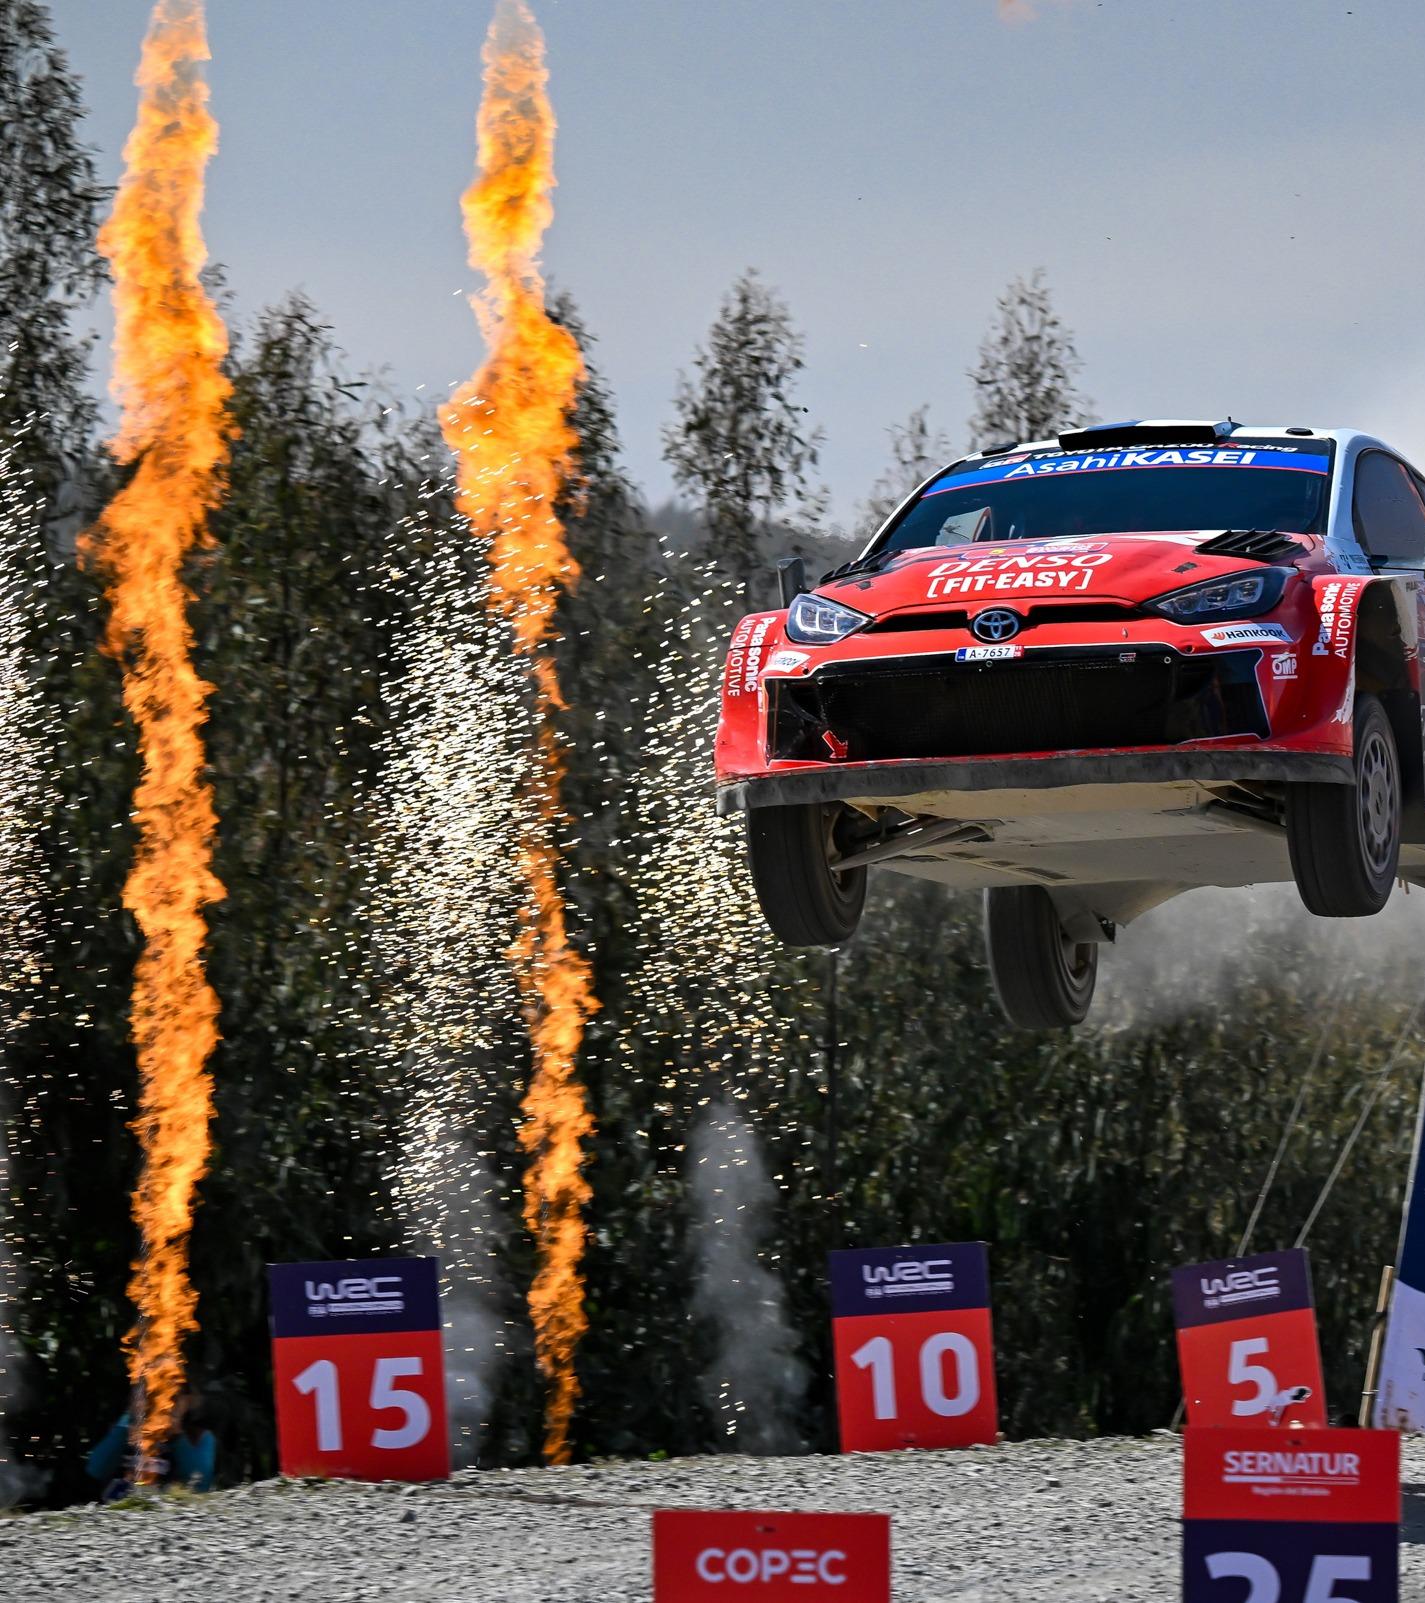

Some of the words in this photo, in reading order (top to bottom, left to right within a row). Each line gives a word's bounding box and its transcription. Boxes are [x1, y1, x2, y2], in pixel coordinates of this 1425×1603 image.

[1004, 451, 1256, 478] AsahiKASEI
[927, 553, 1114, 578] DENSO
[1312, 582, 1343, 656] Panasonic
[1334, 582, 1361, 659] AUTOMOTIVE
[727, 619, 756, 697] AUTOMOTIVE
[744, 617, 777, 692] Panasonic
[969, 647, 1011, 659] A-7657
[305, 1276, 404, 1300] WRC
[861, 1259, 954, 1283] WRC
[1200, 1267, 1280, 1295] WRC
[851, 1332, 981, 1420] 10
[1227, 1337, 1279, 1417] 5
[292, 1356, 432, 1452] 15
[1223, 1450, 1360, 1475] SERNATUR
[695, 1547, 847, 1584] COPEC
